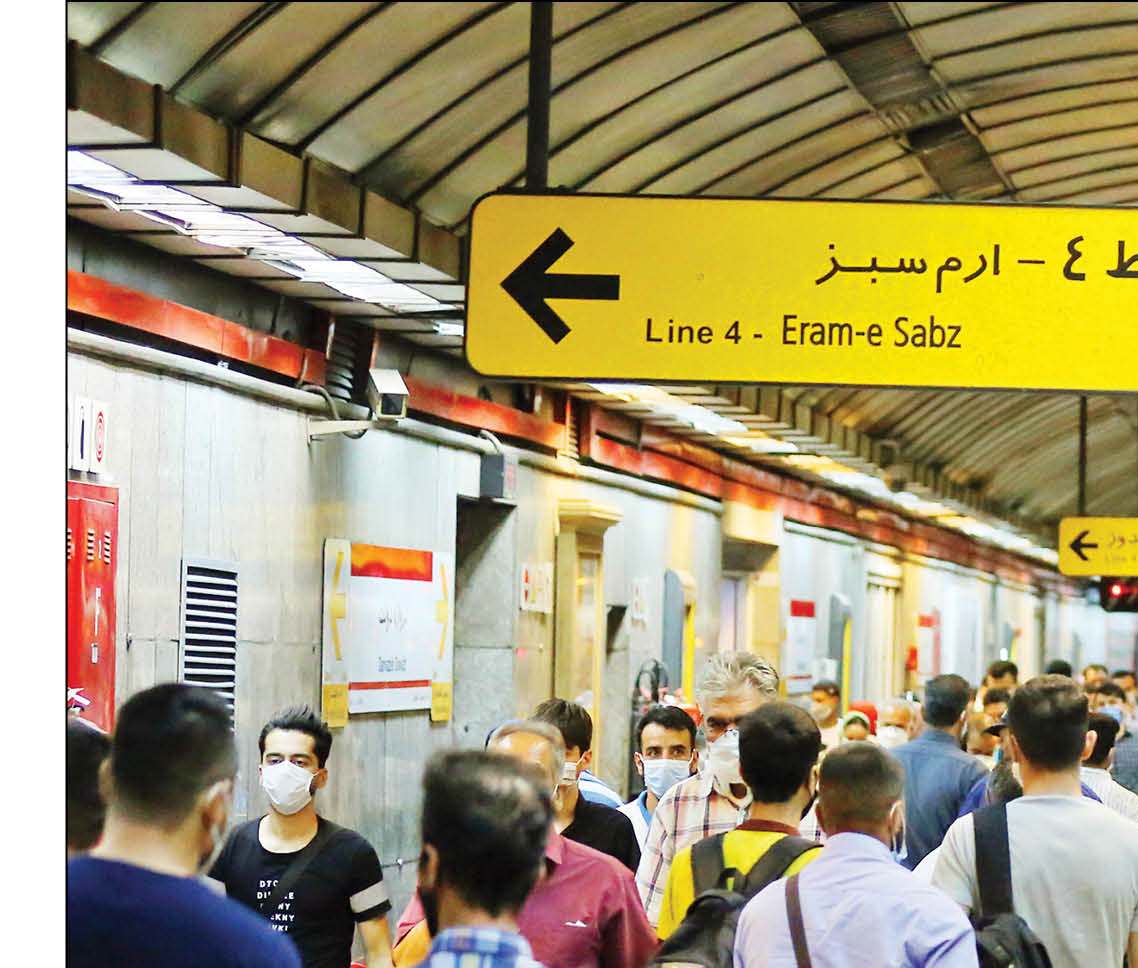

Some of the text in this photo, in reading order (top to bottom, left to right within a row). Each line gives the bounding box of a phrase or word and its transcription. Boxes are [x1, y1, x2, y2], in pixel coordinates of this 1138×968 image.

[814, 243, 928, 286] سبز
[935, 243, 1001, 294] ارم
[645, 317, 714, 345] Line
[724, 320, 742, 345] 4
[782, 314, 883, 347] Eram-e
[894, 315, 962, 349] Sabz
